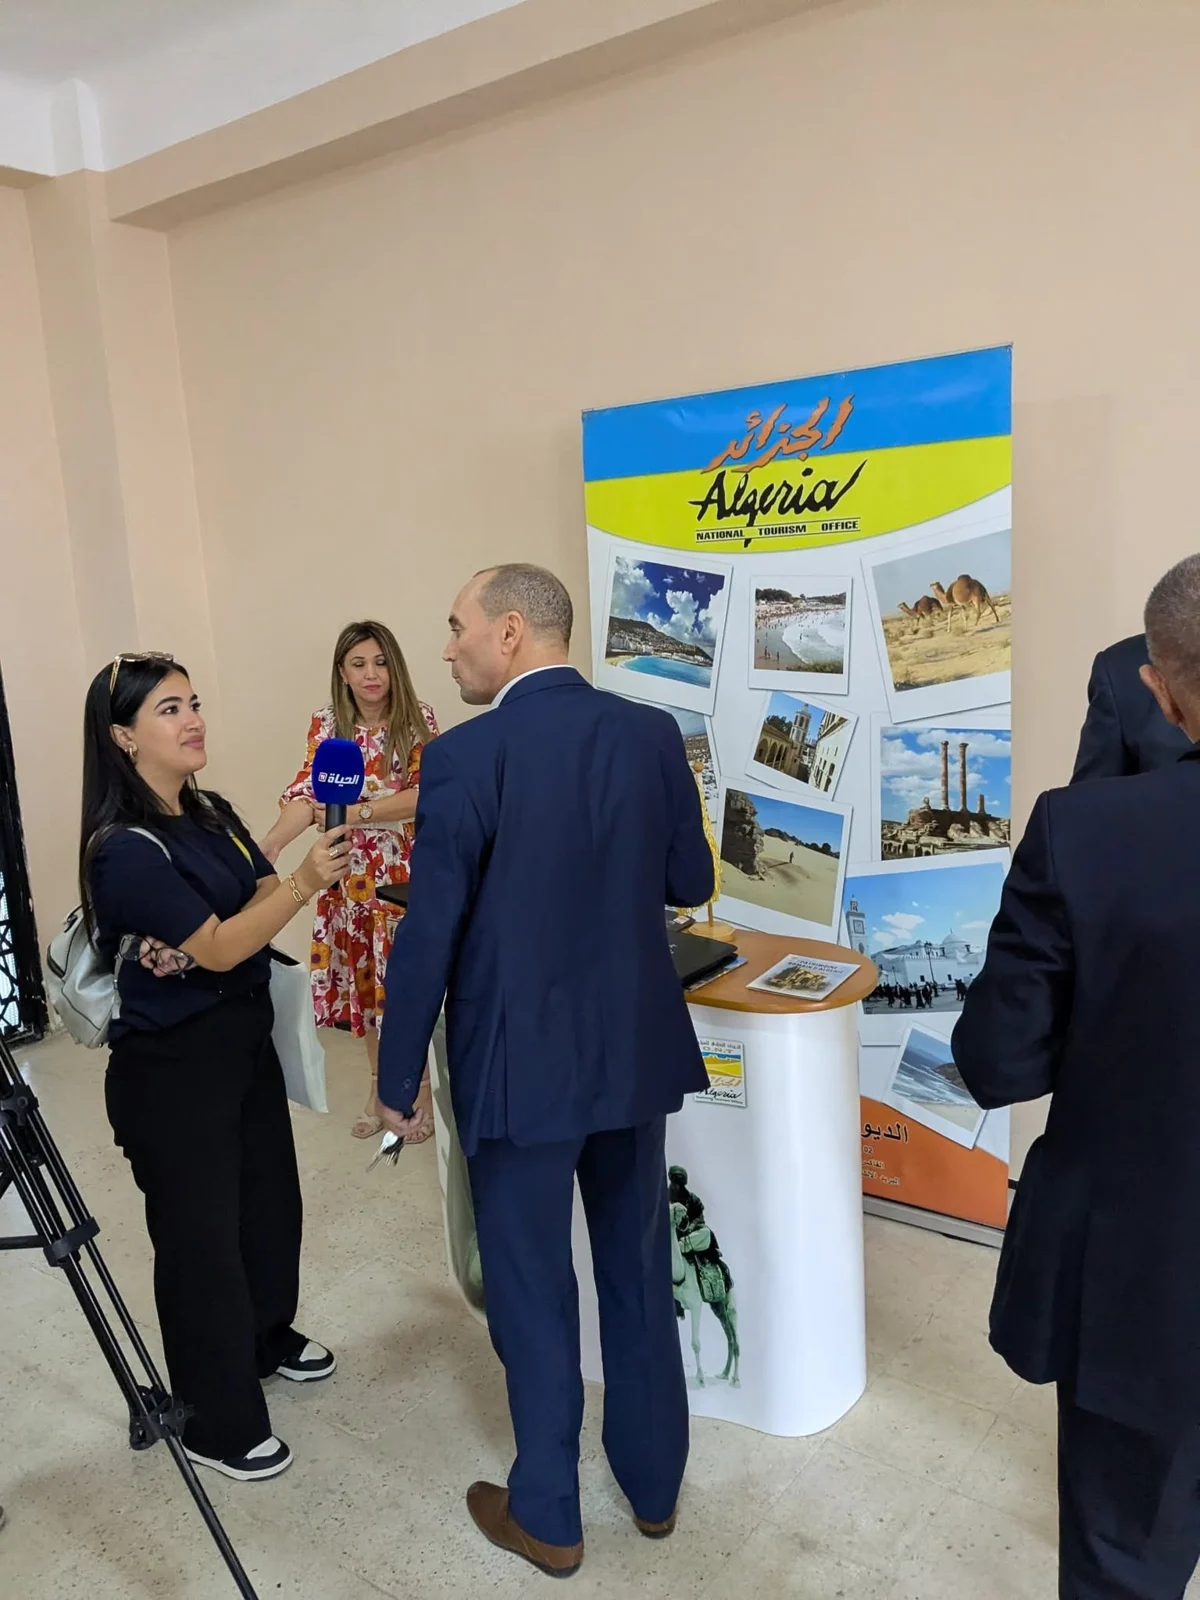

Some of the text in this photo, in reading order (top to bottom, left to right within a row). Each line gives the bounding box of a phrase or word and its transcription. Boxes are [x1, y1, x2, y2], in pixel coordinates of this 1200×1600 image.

[700, 394, 855, 474] الجزائر
[688, 458, 868, 548] Algeria
[696, 520, 859, 541] NATIONAL TOURISM OFFICE
[327, 773, 360, 787] الحياة
[861, 1122, 909, 1142] الديو
